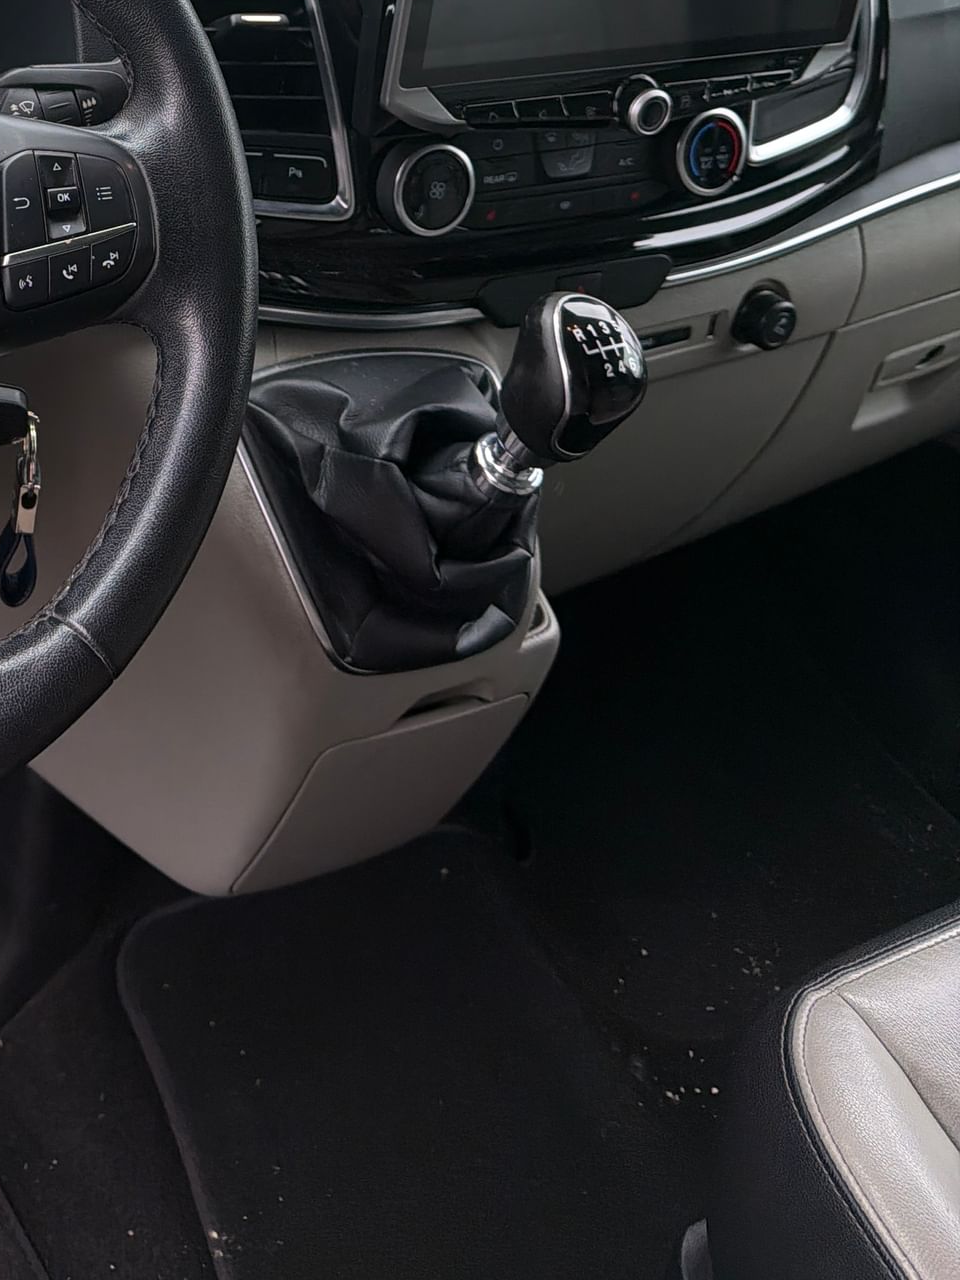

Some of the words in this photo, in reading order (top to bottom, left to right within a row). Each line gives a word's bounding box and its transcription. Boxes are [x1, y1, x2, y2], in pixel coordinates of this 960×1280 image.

[483, 175, 505, 184] REAR
[57, 192, 71, 203] OK
[572, 327, 586, 342] R
[586, 323, 599, 337] 1
[598, 321, 611, 335] 3
[604, 362, 616, 378] 2
[618, 360, 627, 374] 4
[628, 357, 638, 372] 6
